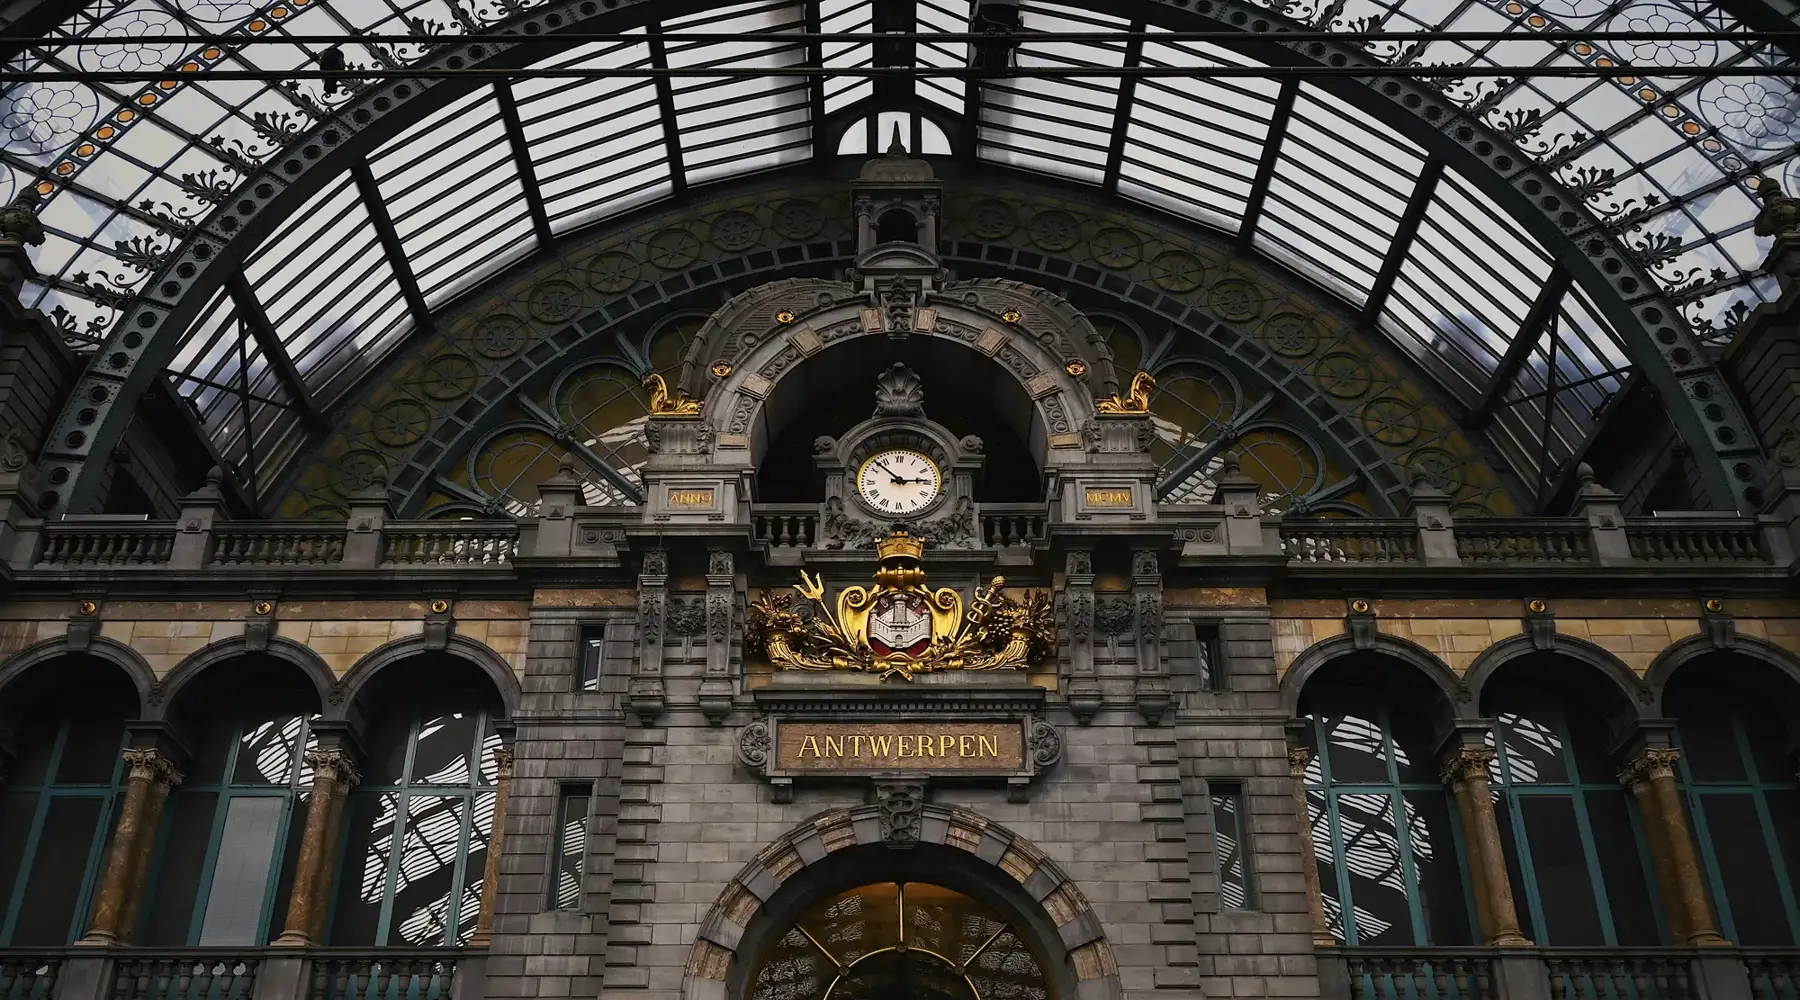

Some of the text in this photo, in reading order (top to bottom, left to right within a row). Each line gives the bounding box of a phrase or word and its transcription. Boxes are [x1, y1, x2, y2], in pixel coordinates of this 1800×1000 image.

[670, 492, 712, 503] ANNO
[1086, 492, 1130, 502] MCMV
[796, 734, 998, 758] ANTWERPEN
